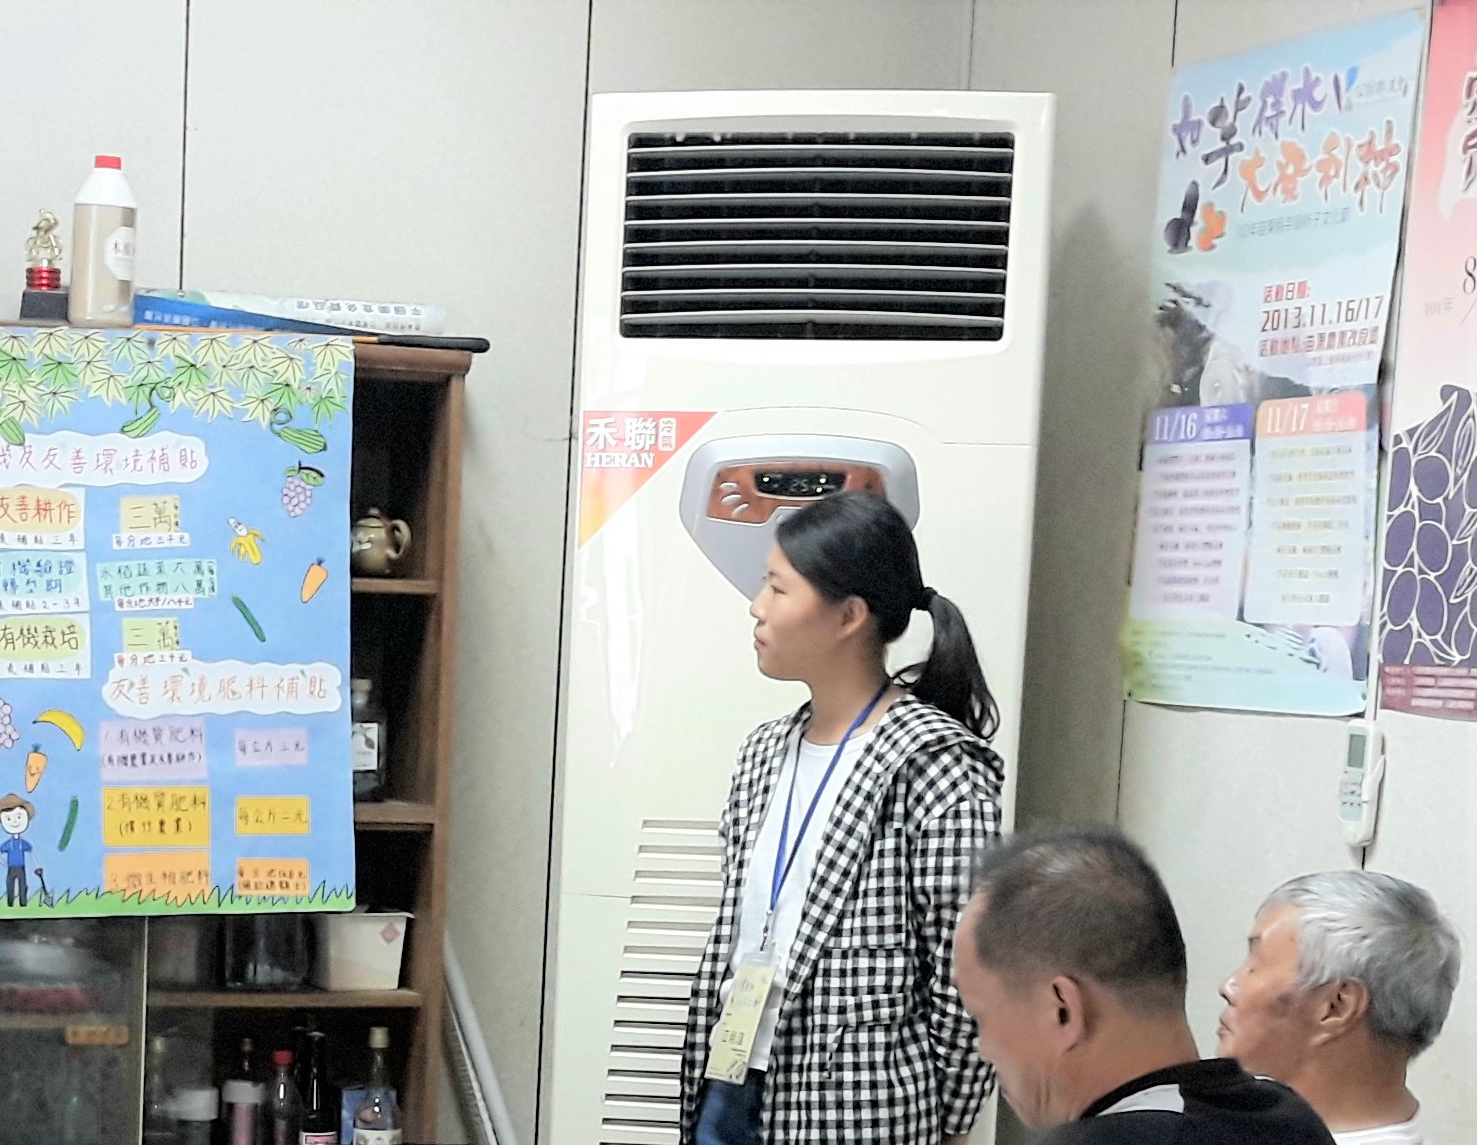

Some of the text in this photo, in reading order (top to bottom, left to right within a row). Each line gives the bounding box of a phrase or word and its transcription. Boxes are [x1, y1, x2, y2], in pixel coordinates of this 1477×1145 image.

[1260, 296, 1385, 333] 2013.11.16/17
[585, 416, 657, 451] 禾聯
[585, 452, 655, 468] HERAN
